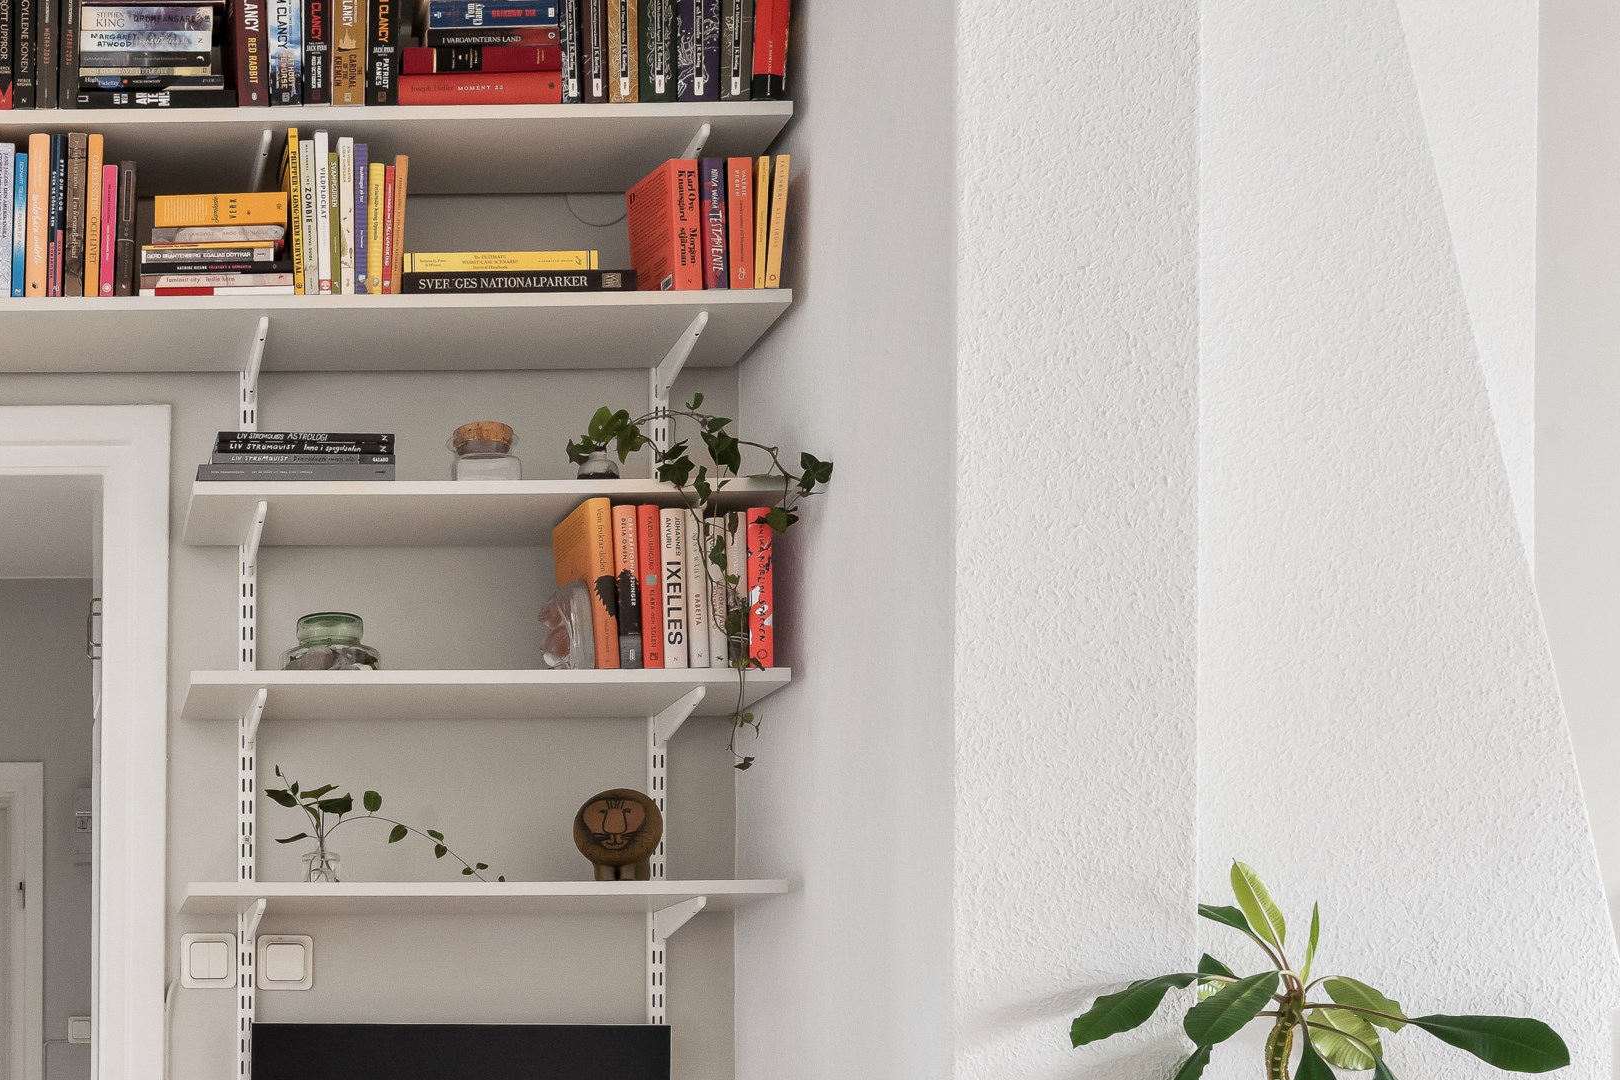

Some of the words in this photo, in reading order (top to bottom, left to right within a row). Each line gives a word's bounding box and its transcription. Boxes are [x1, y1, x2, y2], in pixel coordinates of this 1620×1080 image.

[20, 0, 30, 40] GYLLENE
[96, 18, 125, 28] KING
[311, 2, 321, 40] CLANCY
[378, 4, 389, 43] CLANCY
[465, 3, 475, 20] Tom
[473, 3, 485, 26] Clancy
[491, 9, 522, 17] RAINBOW
[90, 32, 137, 40] MARGARET
[276, 7, 288, 50] CLANCY
[445, 36, 501, 44] VARGAVINTERNS
[20, 42, 30, 73] SONEN
[247, 37, 256, 53] RED
[248, 56, 258, 84] RABBIT
[334, 55, 343, 87] KREMLIN
[348, 53, 357, 89] CARDINAL
[375, 61, 383, 86] GAMES
[382, 58, 390, 89] PATRIOT
[135, 92, 147, 105] AR
[147, 92, 159, 104] TE
[411, 85, 432, 94] Joseph
[330, 161, 339, 209] SVAMPGUIDEN
[687, 169, 696, 191] Karl
[710, 168, 718, 188] NINA
[91, 171, 99, 215] KONSTEN
[305, 187, 313, 223] ZOMBIE
[319, 167, 327, 219] VILDPLOCKAT
[688, 192, 697, 212] Ove
[229, 198, 237, 220] VERK
[290, 151, 298, 192] PREPPER'S
[294, 237, 302, 276] SURVIVAL
[90, 216, 98, 238] OCH
[89, 238, 97, 265] LIVET
[679, 227, 689, 266] stjärnan
[688, 227, 698, 264] Morgon
[709, 209, 724, 272] TESTAMENTE
[190, 276, 201, 285] city
[419, 278, 478, 289] SVERGES
[480, 276, 588, 289] NATIONALPARKER
[246, 443, 296, 451] STRÖMQUIST
[286, 432, 329, 442] ASTROLOGI
[596, 508, 604, 523] Vem
[597, 524, 605, 550] fruktar
[757, 526, 766, 553] NNIKA
[629, 576, 637, 606] SJUNGER
[666, 561, 683, 645] IXELLES
